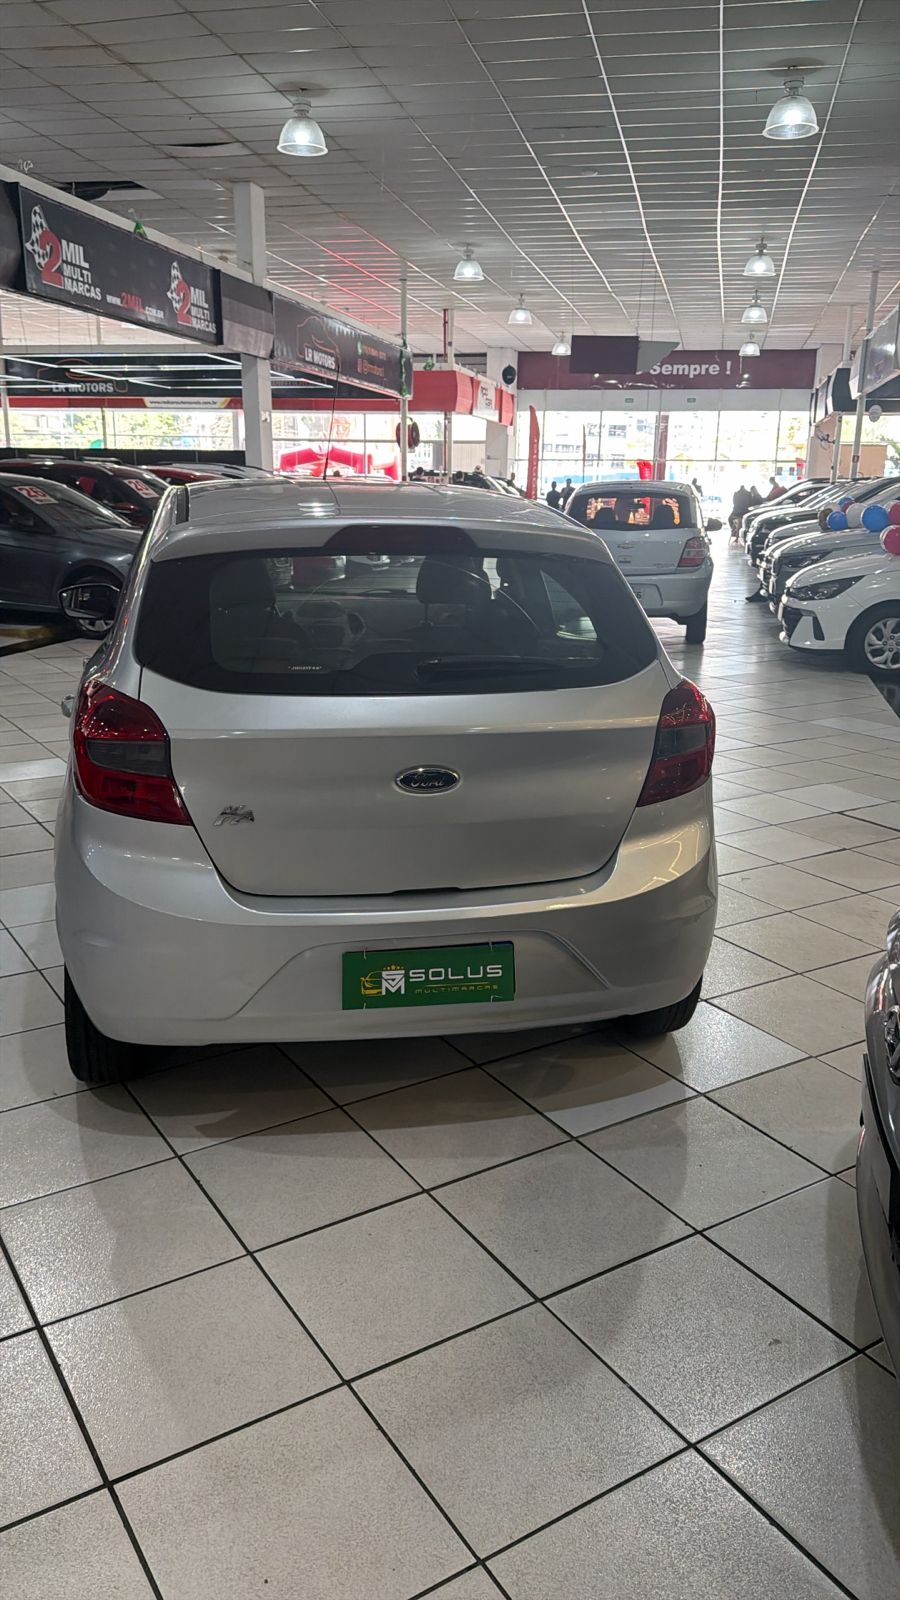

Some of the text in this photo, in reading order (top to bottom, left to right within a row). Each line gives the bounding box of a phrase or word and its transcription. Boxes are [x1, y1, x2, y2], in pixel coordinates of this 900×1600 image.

[61, 239, 89, 269] MIL
[63, 263, 92, 284] MULTI
[64, 277, 102, 301] MARCAS
[190, 286, 209, 308] MIL
[191, 305, 210, 321] MULTI
[192, 316, 217, 333] MARCAS
[304, 346, 336, 370] LR MOTORS
[650, 361, 720, 379] Sempre
[410, 772, 447, 788] Ford
[409, 964, 503, 982] SOLUS
[415, 985, 499, 995] MULTIMARCAS
